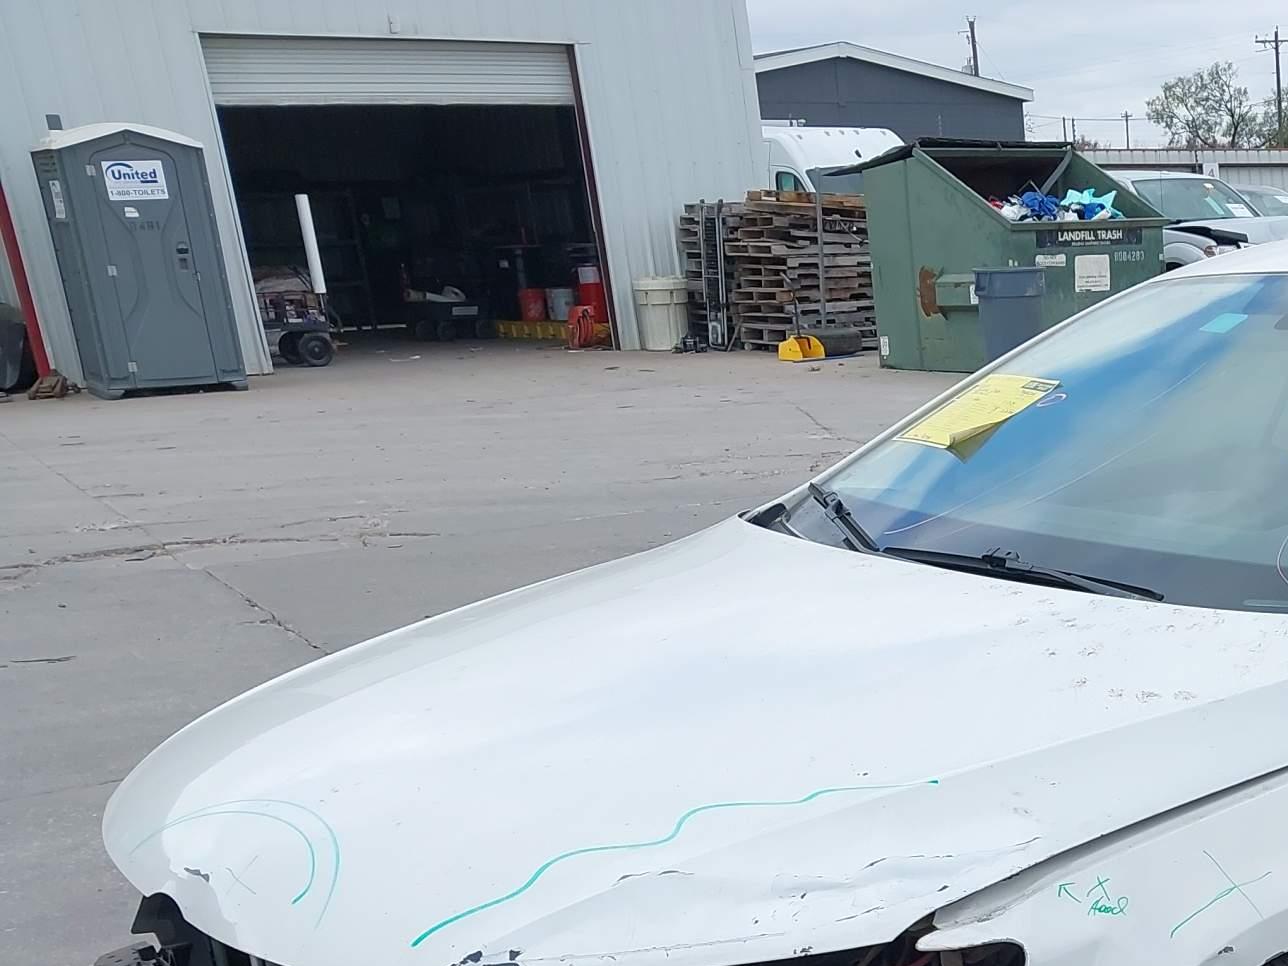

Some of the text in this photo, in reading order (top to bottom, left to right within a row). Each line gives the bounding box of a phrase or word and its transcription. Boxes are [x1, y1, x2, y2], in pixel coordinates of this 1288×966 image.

[111, 168, 157, 180] United
[1058, 229, 1123, 241] LANDFILL TRASH
